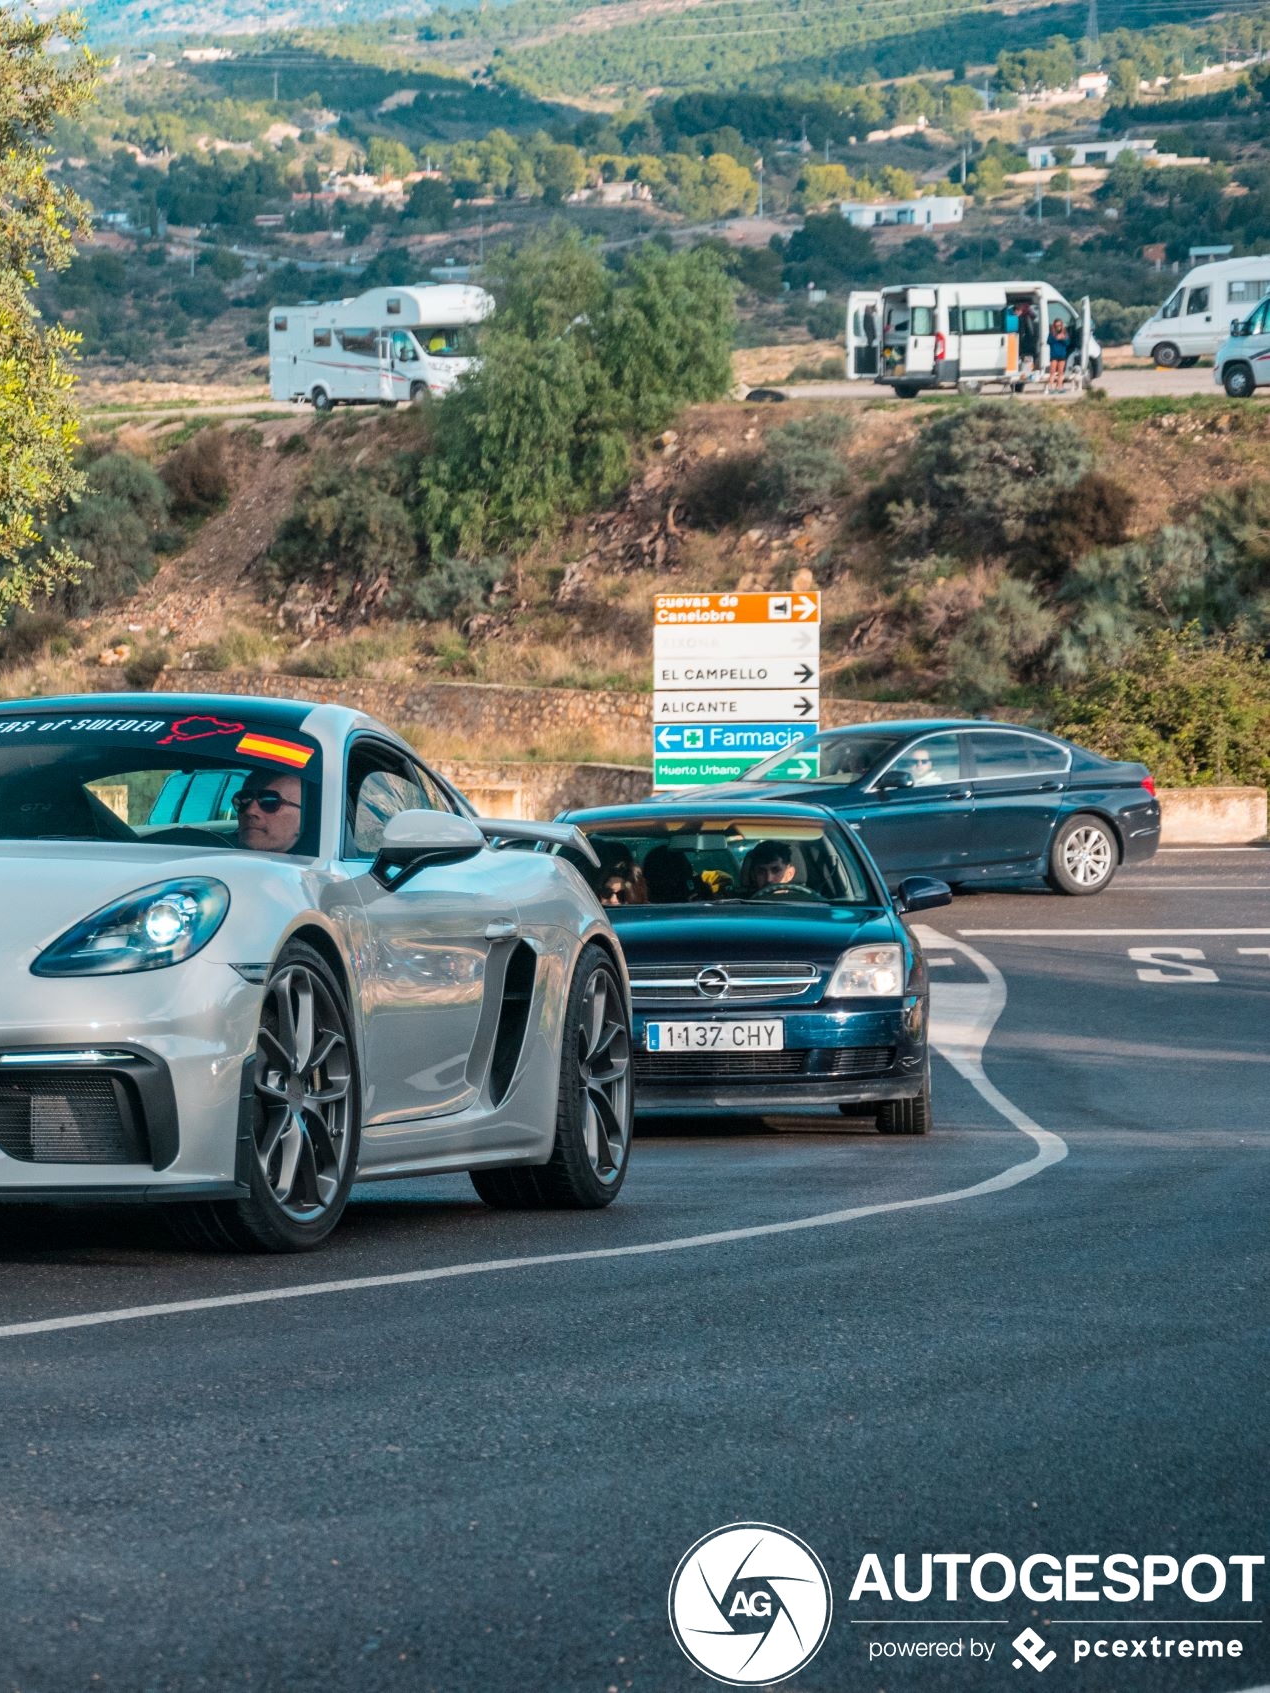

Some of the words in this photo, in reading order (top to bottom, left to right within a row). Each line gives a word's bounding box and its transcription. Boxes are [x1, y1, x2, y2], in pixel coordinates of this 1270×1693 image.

[656, 597, 710, 608] cuevas
[719, 595, 738, 607] de
[657, 609, 736, 623] Canelobre
[662, 669, 679, 680] EL
[685, 669, 768, 680] CAMPELLO
[661, 701, 738, 713] ALICANTE
[38, 719, 72, 731] of
[70, 719, 166, 732] SWEDEN
[710, 728, 805, 746] Farmacia
[659, 765, 697, 775] Huerto
[700, 765, 740, 775] Urbano
[667, 1026, 722, 1046] 1137
[733, 1026, 775, 1046] CHY
